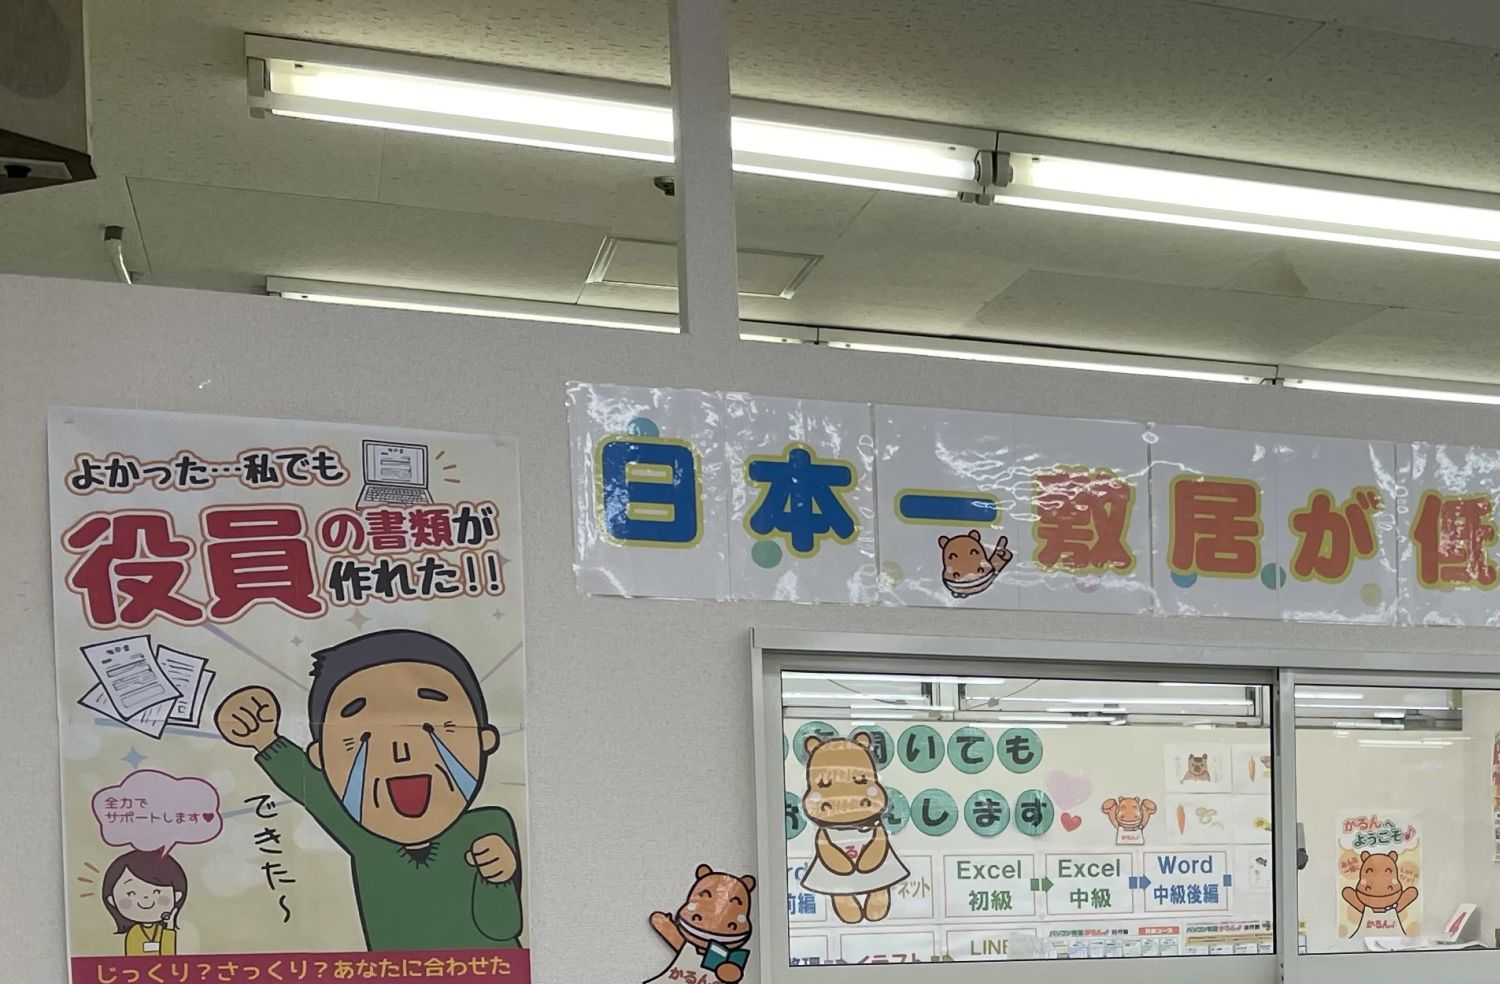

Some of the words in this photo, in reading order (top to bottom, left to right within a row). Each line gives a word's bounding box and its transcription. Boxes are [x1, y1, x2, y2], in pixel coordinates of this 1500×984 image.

[321, 506, 495, 551] の書類が
[66, 508, 324, 626] 役員
[105, 797, 147, 809] 全力で
[957, 860, 1022, 880] Excel
[1058, 859, 1121, 878] Excel
[1157, 856, 1213, 875] Word
[968, 890, 1012, 912] 初級
[1069, 888, 1112, 909] 中級
[1153, 884, 1219, 905] 中級後編
